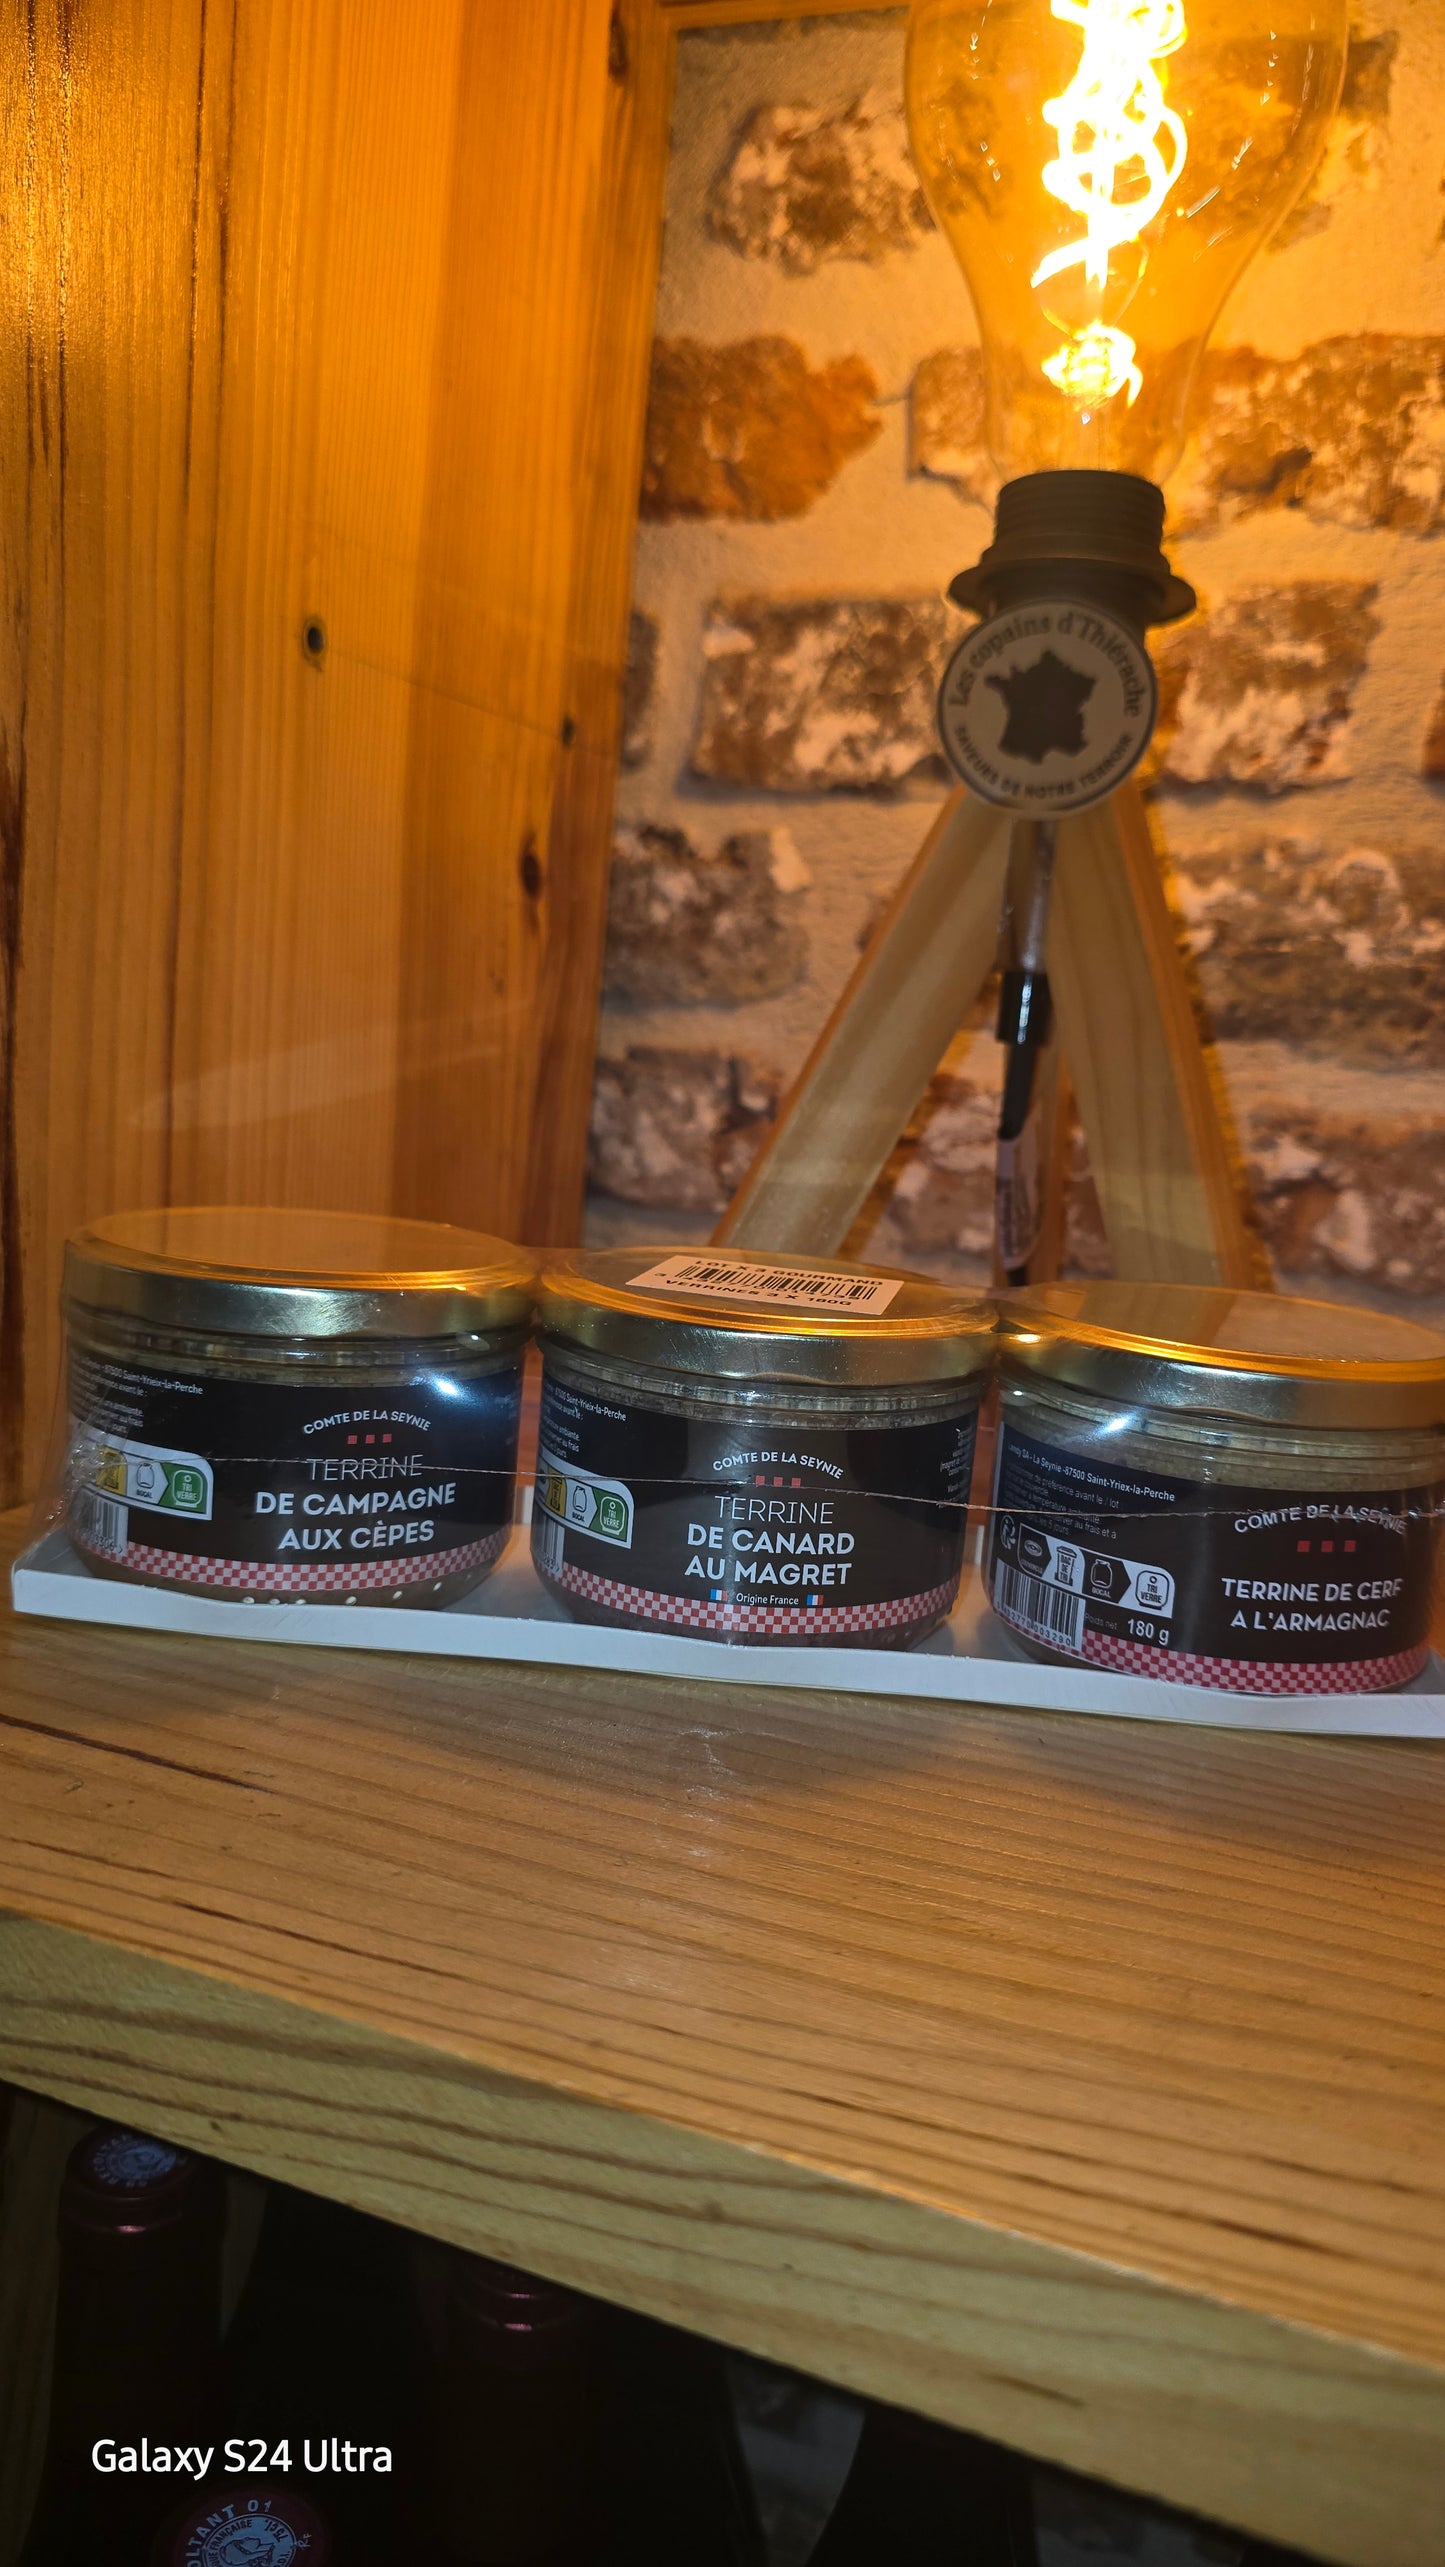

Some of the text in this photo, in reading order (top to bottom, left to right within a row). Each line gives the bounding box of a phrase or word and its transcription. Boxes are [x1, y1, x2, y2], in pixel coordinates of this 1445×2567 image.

[948, 669, 976, 707] Les
[968, 615, 1050, 669] copains
[1024, 780, 1076, 799] NOTRE
[666, 1279, 761, 1296] VERRINES
[773, 1269, 884, 1286] GOURMAND
[303, 1409, 432, 1435] COMTE DE LA SEYNIE
[306, 1454, 424, 1481] TERRINE
[712, 1451, 844, 1480] COMTE DE LA SEYNIE
[255, 1482, 457, 1516] DE CAMPAGNE
[714, 1495, 835, 1525] TERRINE
[1075, 1489, 1095, 1502] avant
[1109, 1497, 1120, 1509] lot
[1234, 1505, 1302, 1534] COMTE
[1306, 1504, 1330, 1519] DE
[277, 1519, 435, 1550] AUX CÈPES
[687, 1523, 855, 1556] DE CANARD
[684, 1555, 852, 1586] AU MAGRET
[736, 1592, 799, 1606] Origine France
[1140, 1591, 1163, 1604] VERRE
[1146, 1583, 1158, 1594] TRI
[1221, 1577, 1403, 1602] TERRINE DE CERF
[1127, 1618, 1169, 1646] 180 g
[1230, 1608, 1391, 1632] A L'ARMAGNAC
